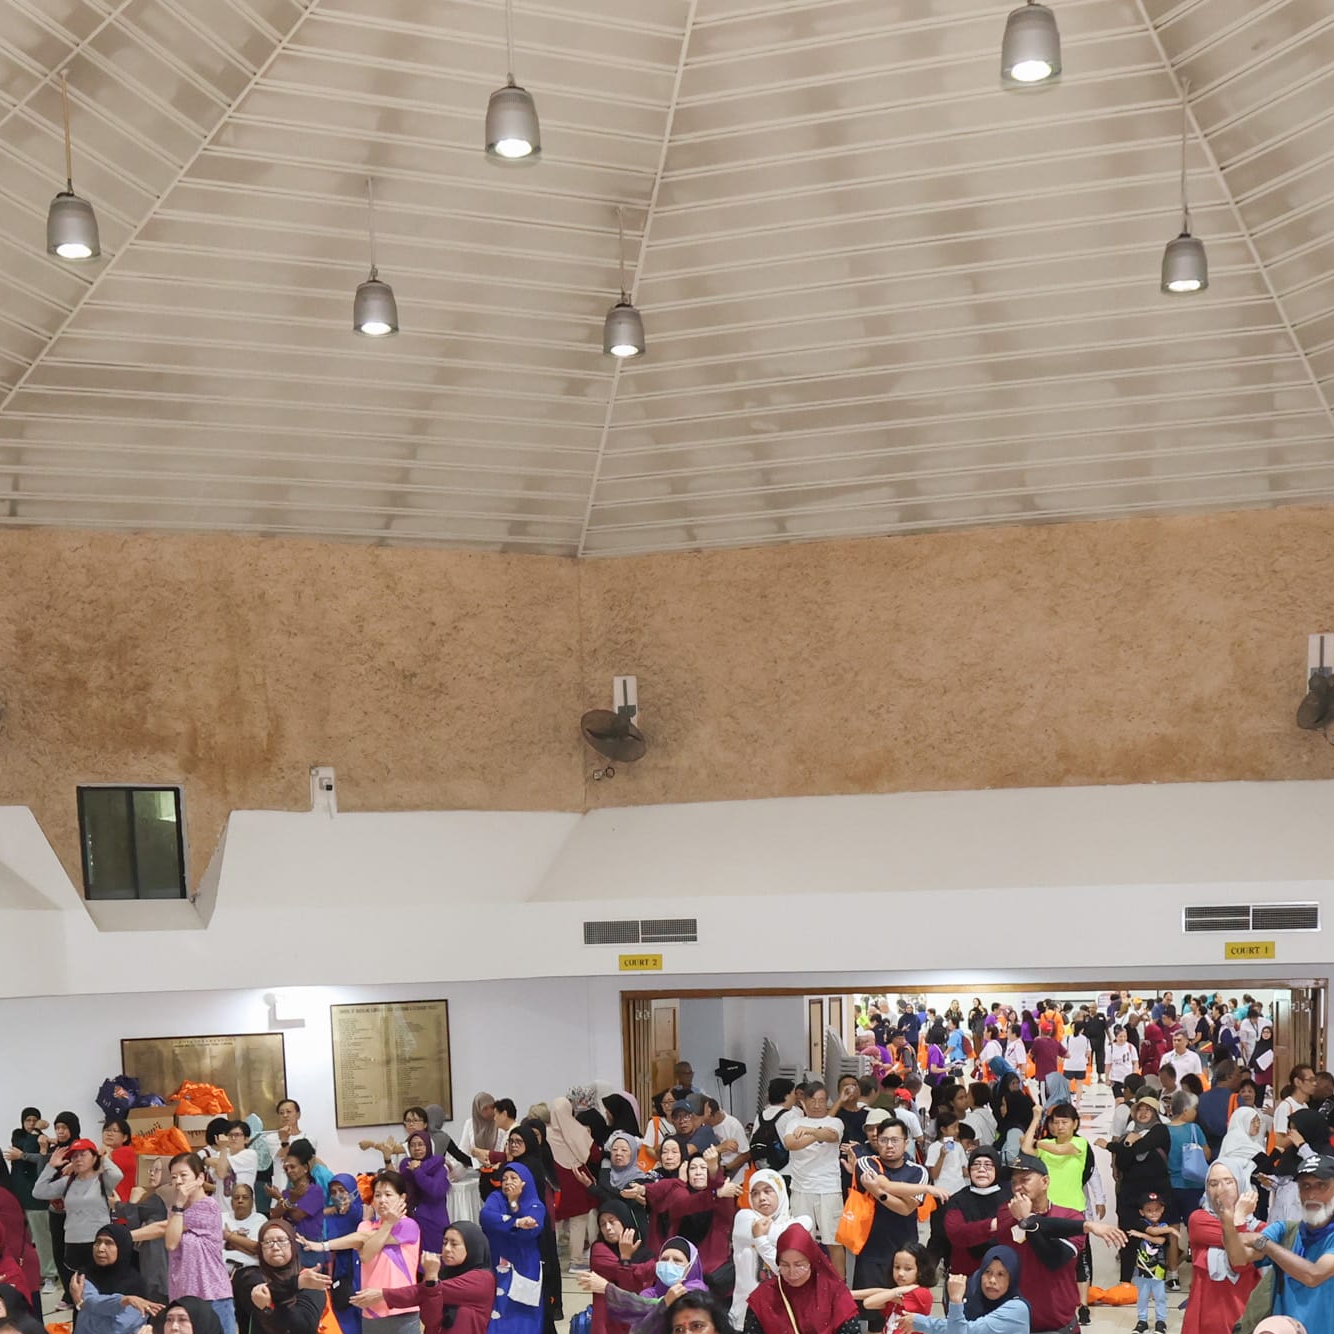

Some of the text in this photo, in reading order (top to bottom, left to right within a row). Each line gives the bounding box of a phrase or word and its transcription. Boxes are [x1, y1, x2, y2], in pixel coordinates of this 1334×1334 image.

[1230, 946, 1260, 955] COURT
[624, 958, 658, 967] COURT 2
